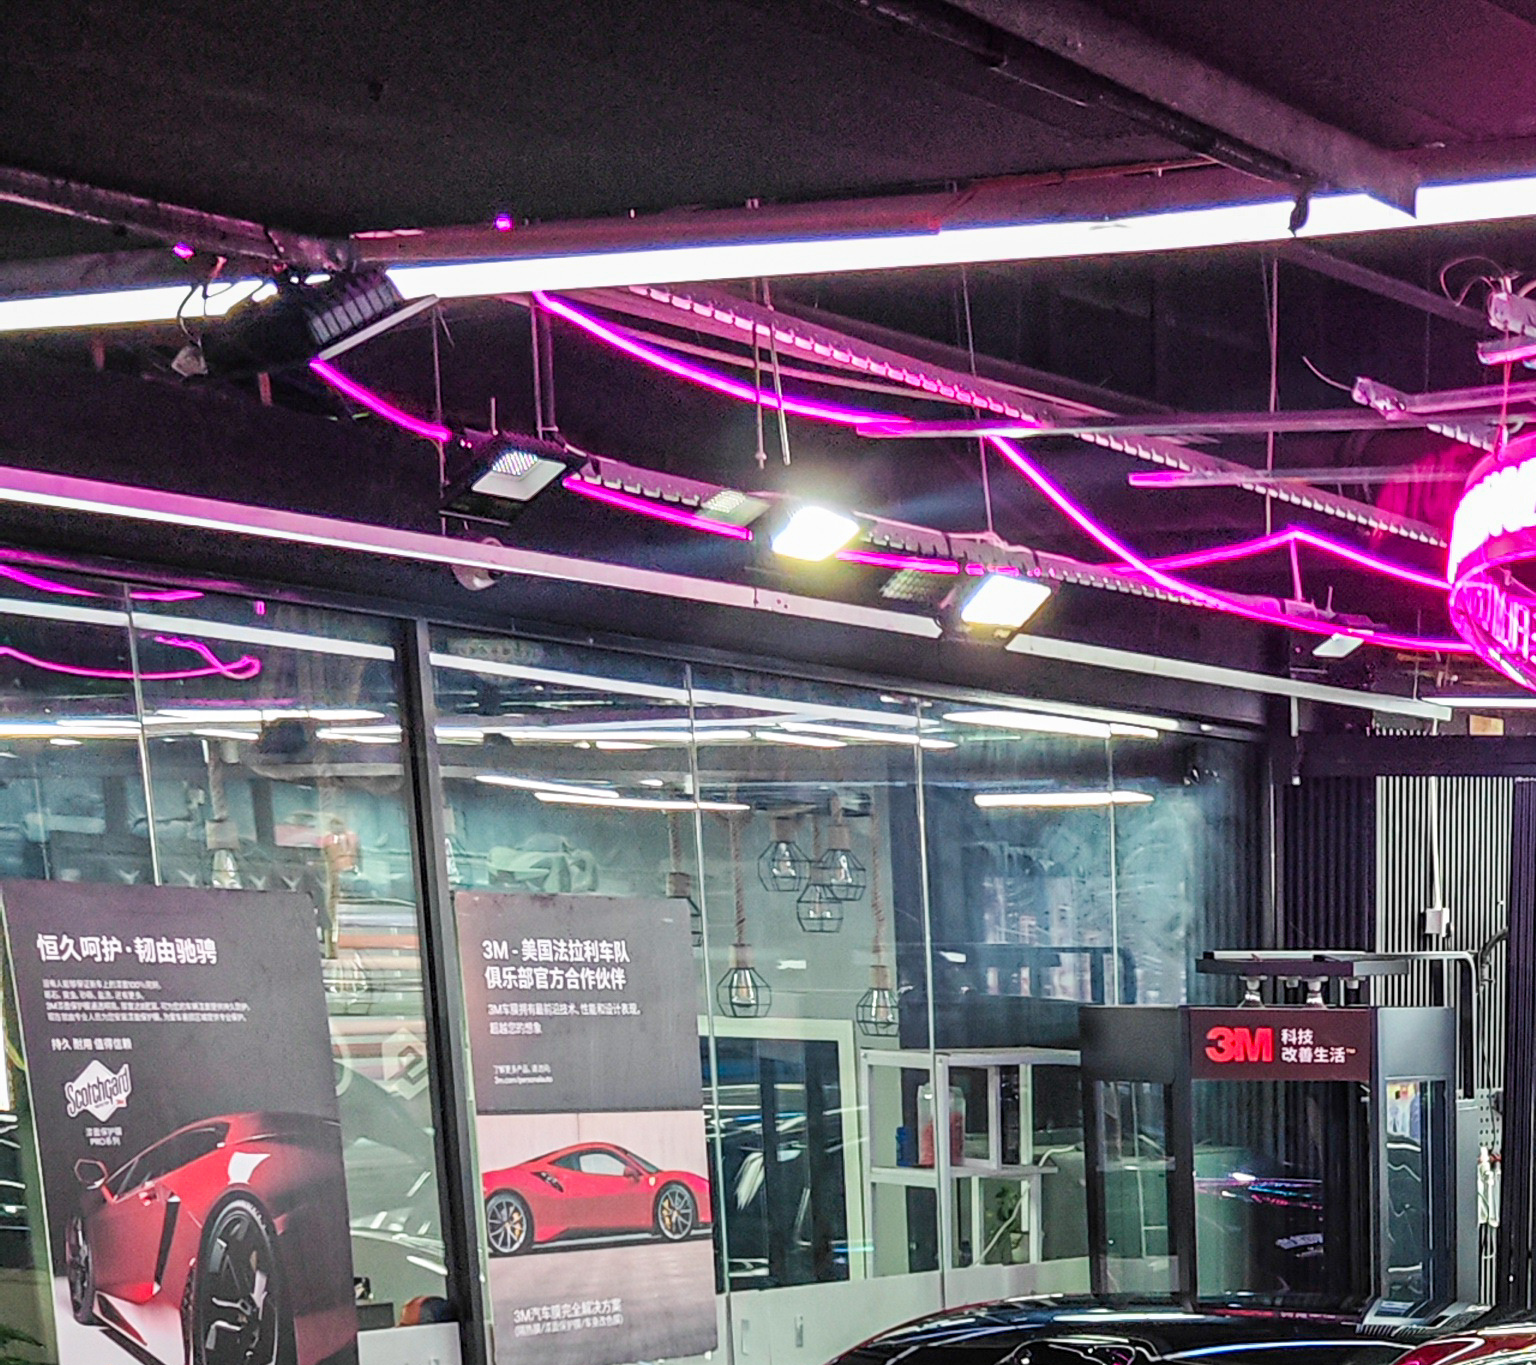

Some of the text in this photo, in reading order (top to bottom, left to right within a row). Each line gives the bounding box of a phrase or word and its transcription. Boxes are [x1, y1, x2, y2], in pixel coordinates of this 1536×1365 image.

[521, 938, 631, 964] 美国法拉利车队
[485, 966, 627, 990] 俱乐部官方合作伙伴
[1205, 1026, 1274, 1063] 3M
[1281, 1028, 1314, 1045] 科技
[66, 1066, 129, 1117] Scotchgard
